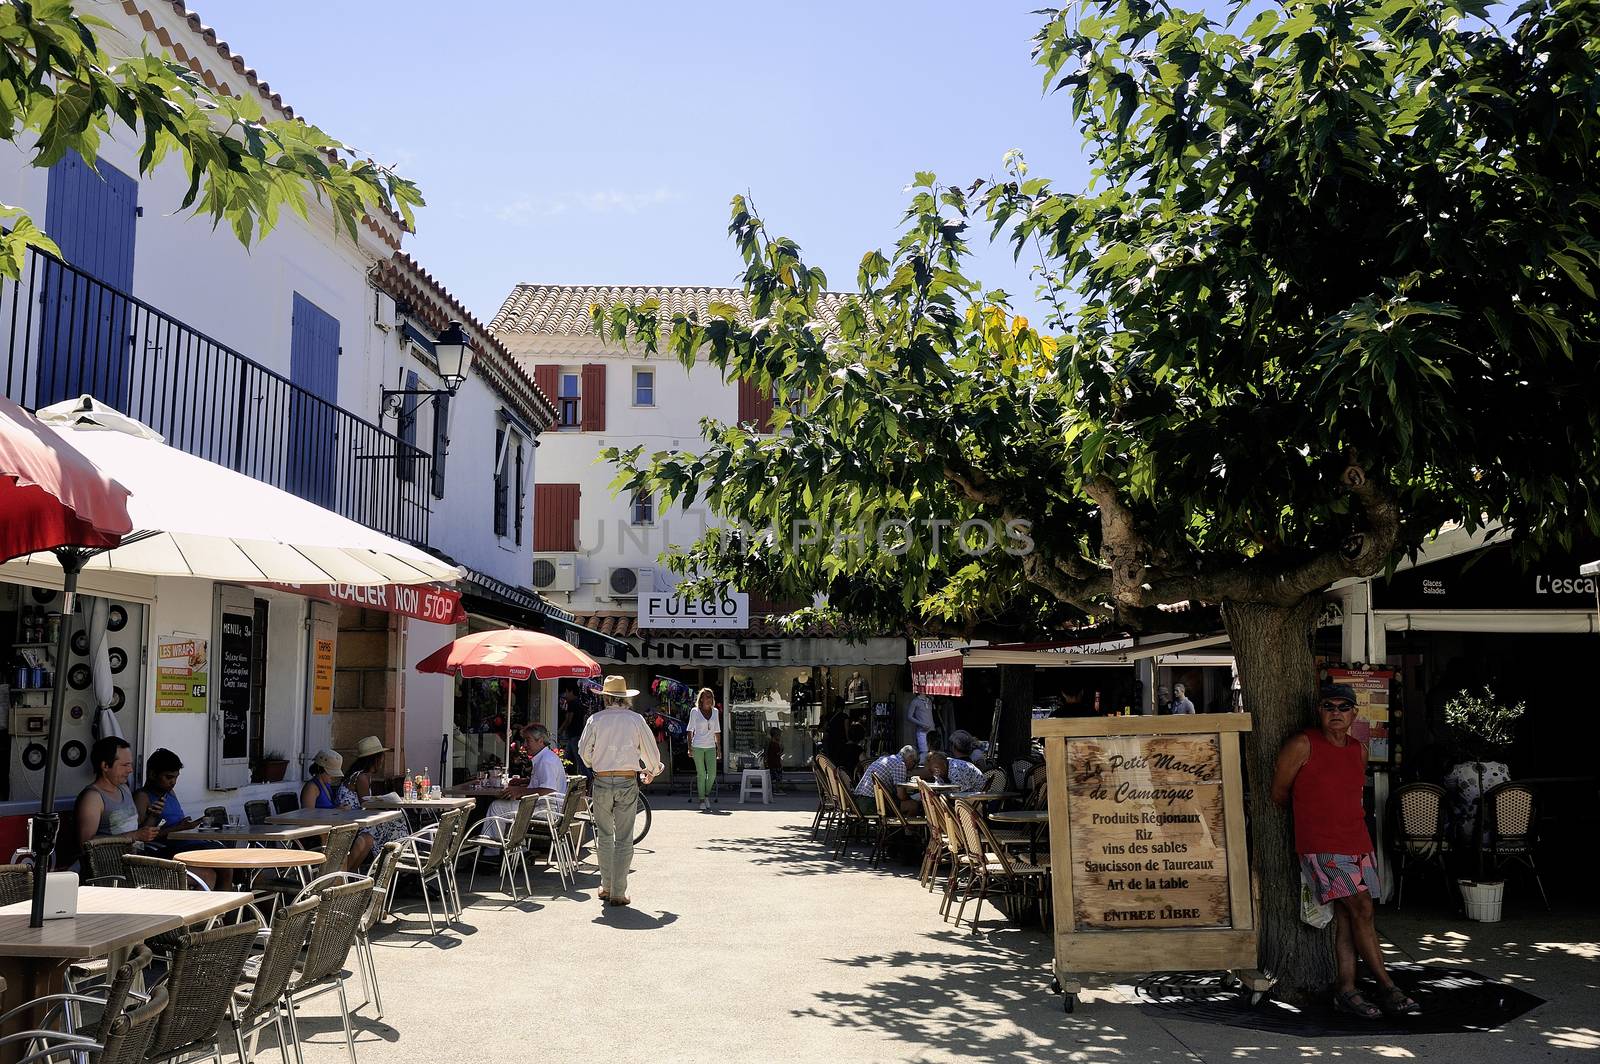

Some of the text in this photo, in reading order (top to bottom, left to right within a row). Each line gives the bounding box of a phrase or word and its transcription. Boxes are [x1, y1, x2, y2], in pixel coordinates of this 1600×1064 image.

[1422, 579, 1443, 587] Glaces
[1423, 587, 1447, 595] Salades
[395, 585, 419, 614] NON
[424, 594, 453, 620] STOP
[649, 598, 738, 616] FUEGO
[920, 641, 954, 649] HOMME
[1110, 755, 1150, 773] Petit
[1152, 753, 1216, 781] Marché
[1090, 784, 1107, 801] de
[1092, 811, 1200, 827] Produits Régionaux
[1135, 829, 1153, 840] Riz
[1102, 842, 1188, 855] vins des sables
[1085, 859, 1214, 872] Saucisson de Taureaux
[1107, 877, 1189, 891] Art de la table
[1103, 906, 1200, 922] ENTREE LIBRE
